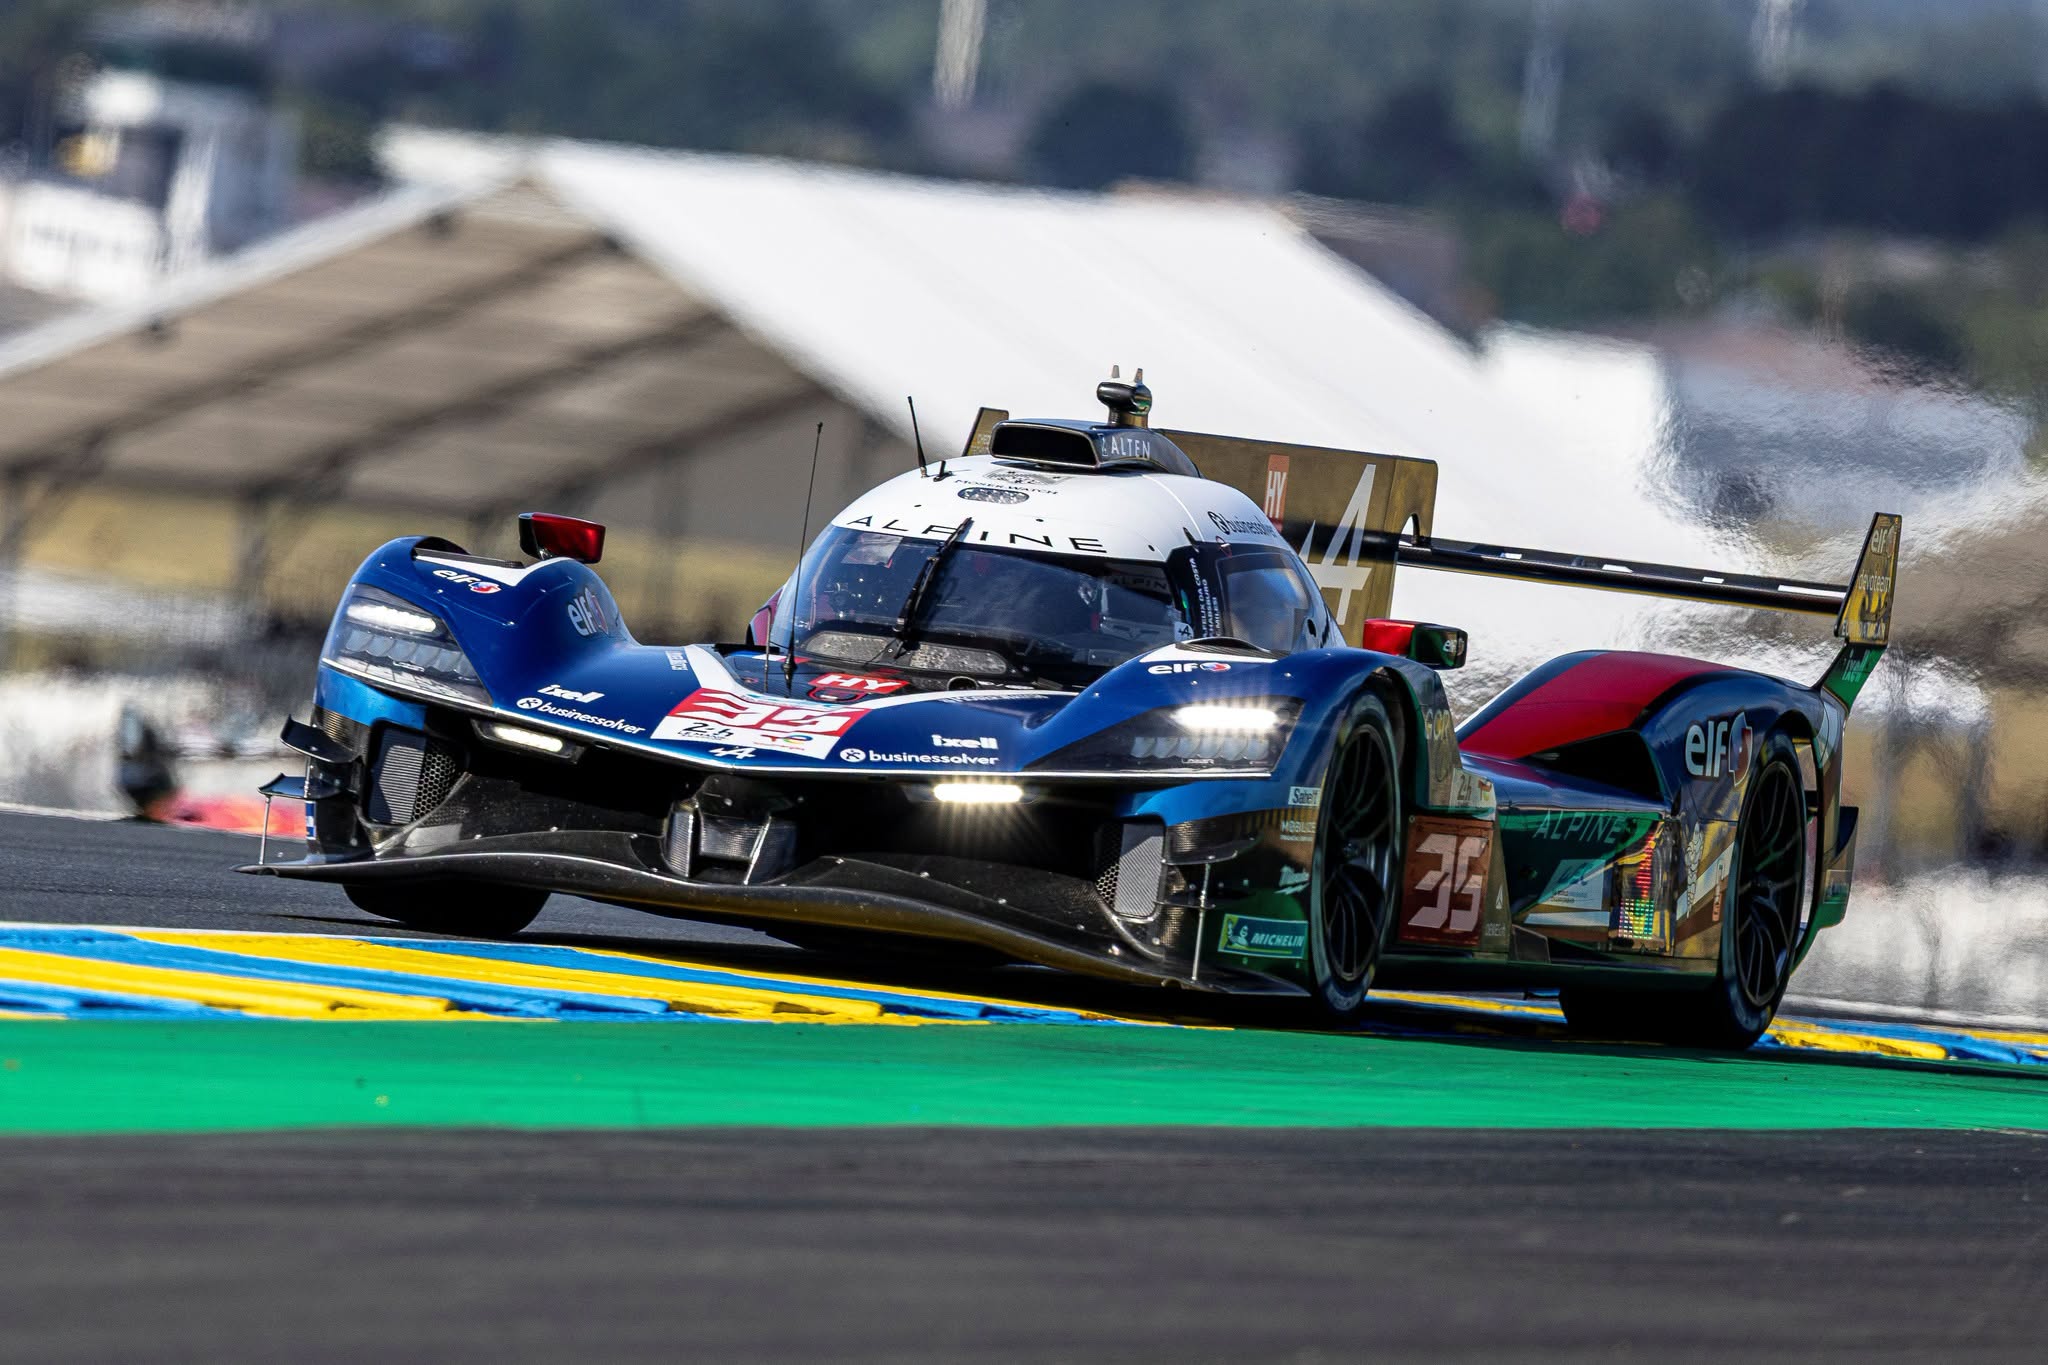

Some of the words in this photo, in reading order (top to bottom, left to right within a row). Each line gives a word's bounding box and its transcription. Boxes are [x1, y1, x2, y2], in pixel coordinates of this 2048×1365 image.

[1111, 435, 1151, 460] ALTEN
[1264, 470, 1288, 519] HY
[846, 515, 1107, 554] ALPINE
[1870, 527, 1889, 554] elf
[433, 569, 481, 587] elf
[1189, 557, 1201, 587] COSTA
[1858, 569, 1891, 593] devoteam
[567, 596, 596, 637] elf
[1147, 662, 1199, 675] elf
[537, 684, 605, 704] ixell
[817, 674, 901, 691] HY
[538, 702, 646, 735] businessolver
[932, 734, 999, 750] ixell
[1685, 720, 1729, 778] elf
[869, 750, 999, 766] businessolver
[1532, 810, 1627, 844] ALPINE
[1407, 833, 1489, 932] 35
[1250, 932, 1305, 948] MICHELIN
